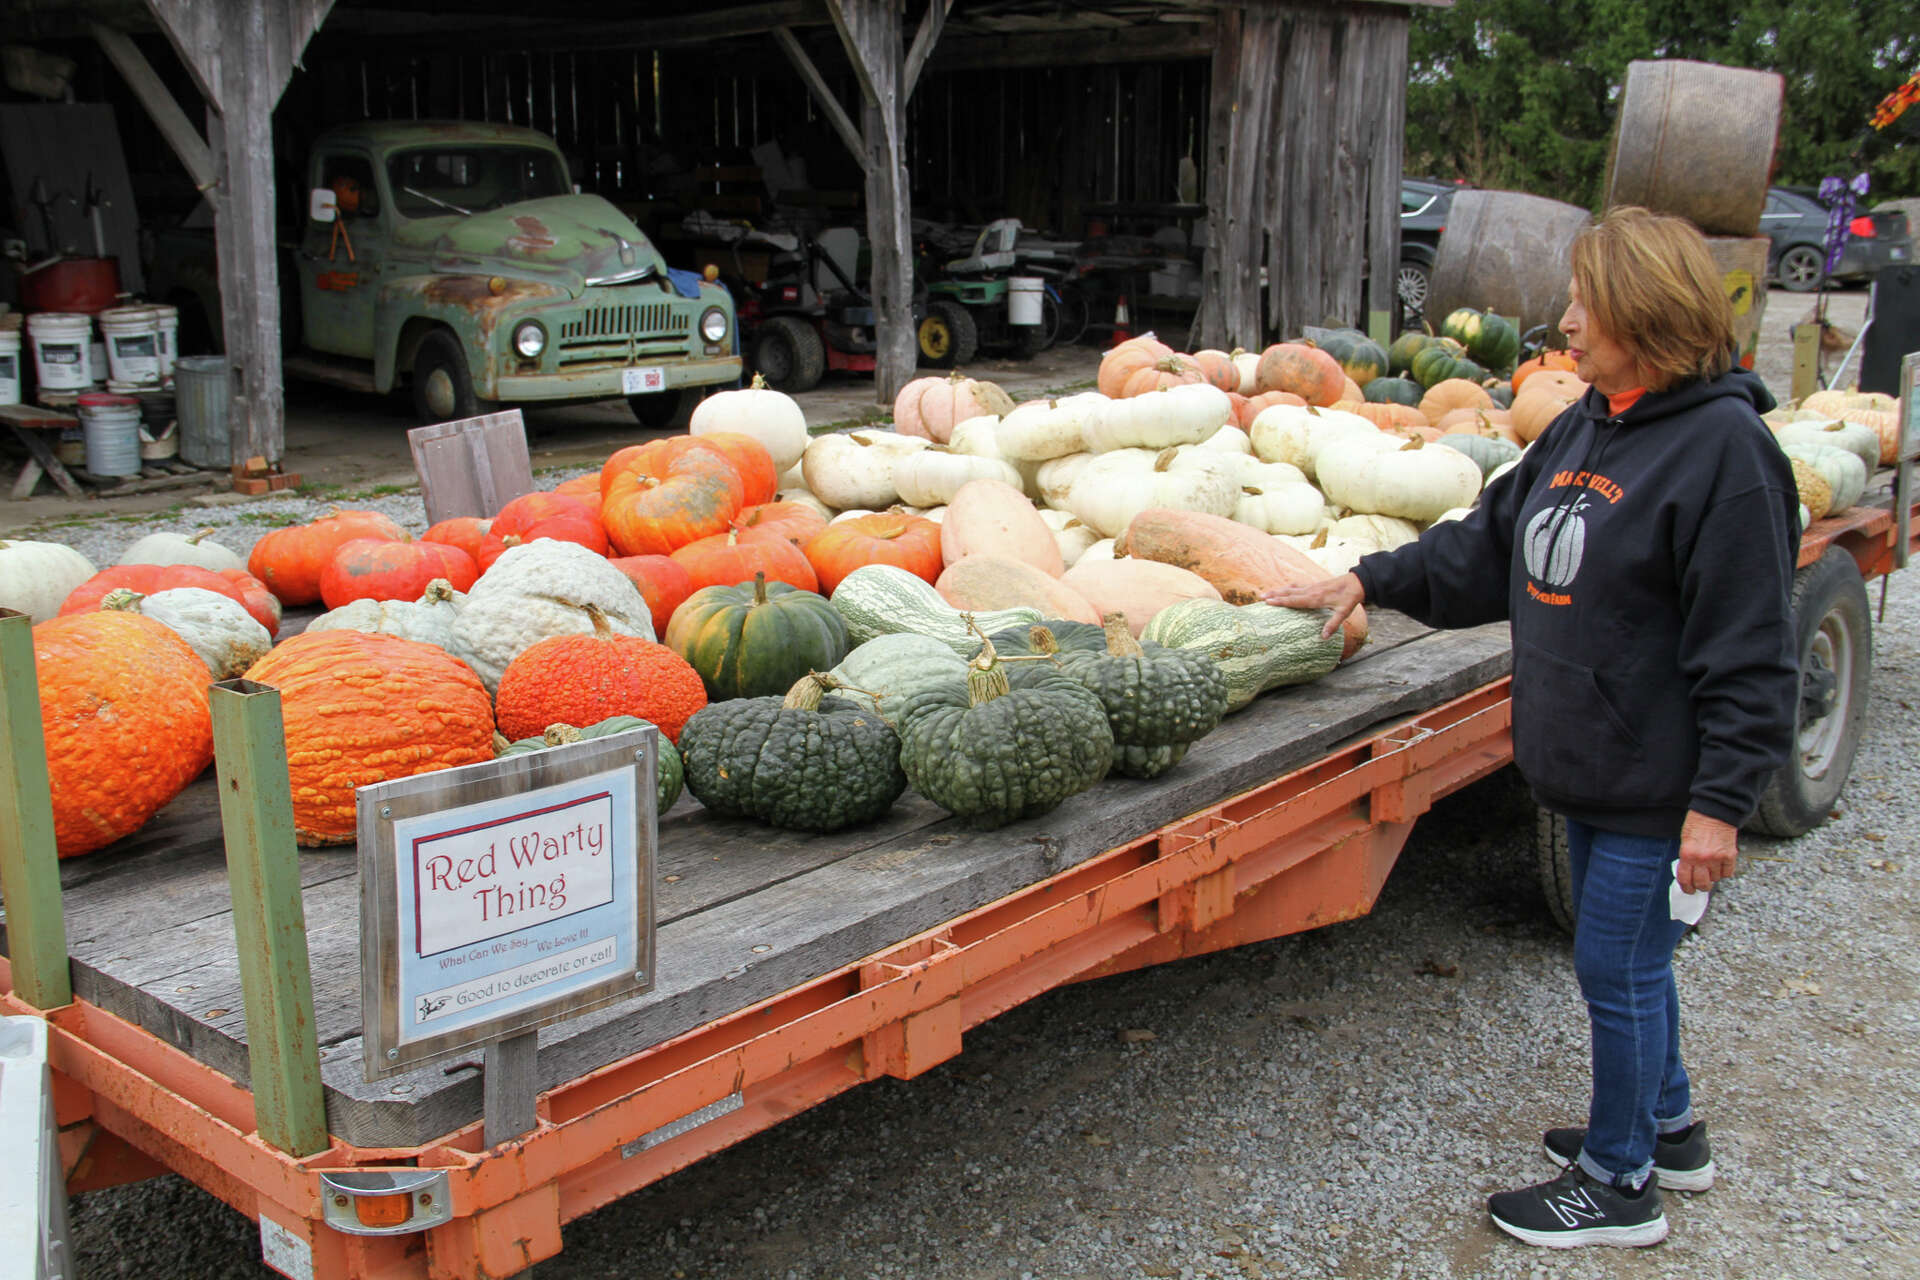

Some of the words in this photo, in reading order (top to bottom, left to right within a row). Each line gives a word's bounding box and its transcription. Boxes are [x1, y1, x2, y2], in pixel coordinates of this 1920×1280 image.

[425, 842, 497, 891] Red
[510, 822, 603, 869] Warty
[473, 873, 567, 921] Thing
[439, 955, 467, 971] What
[469, 948, 489, 962] Can
[491, 943, 507, 955] We
[555, 933, 577, 947] Love
[456, 983, 494, 1006] Good
[497, 980, 511, 993] to
[514, 961, 570, 988] decorate
[573, 956, 587, 969] or
[591, 945, 612, 964] eat!
